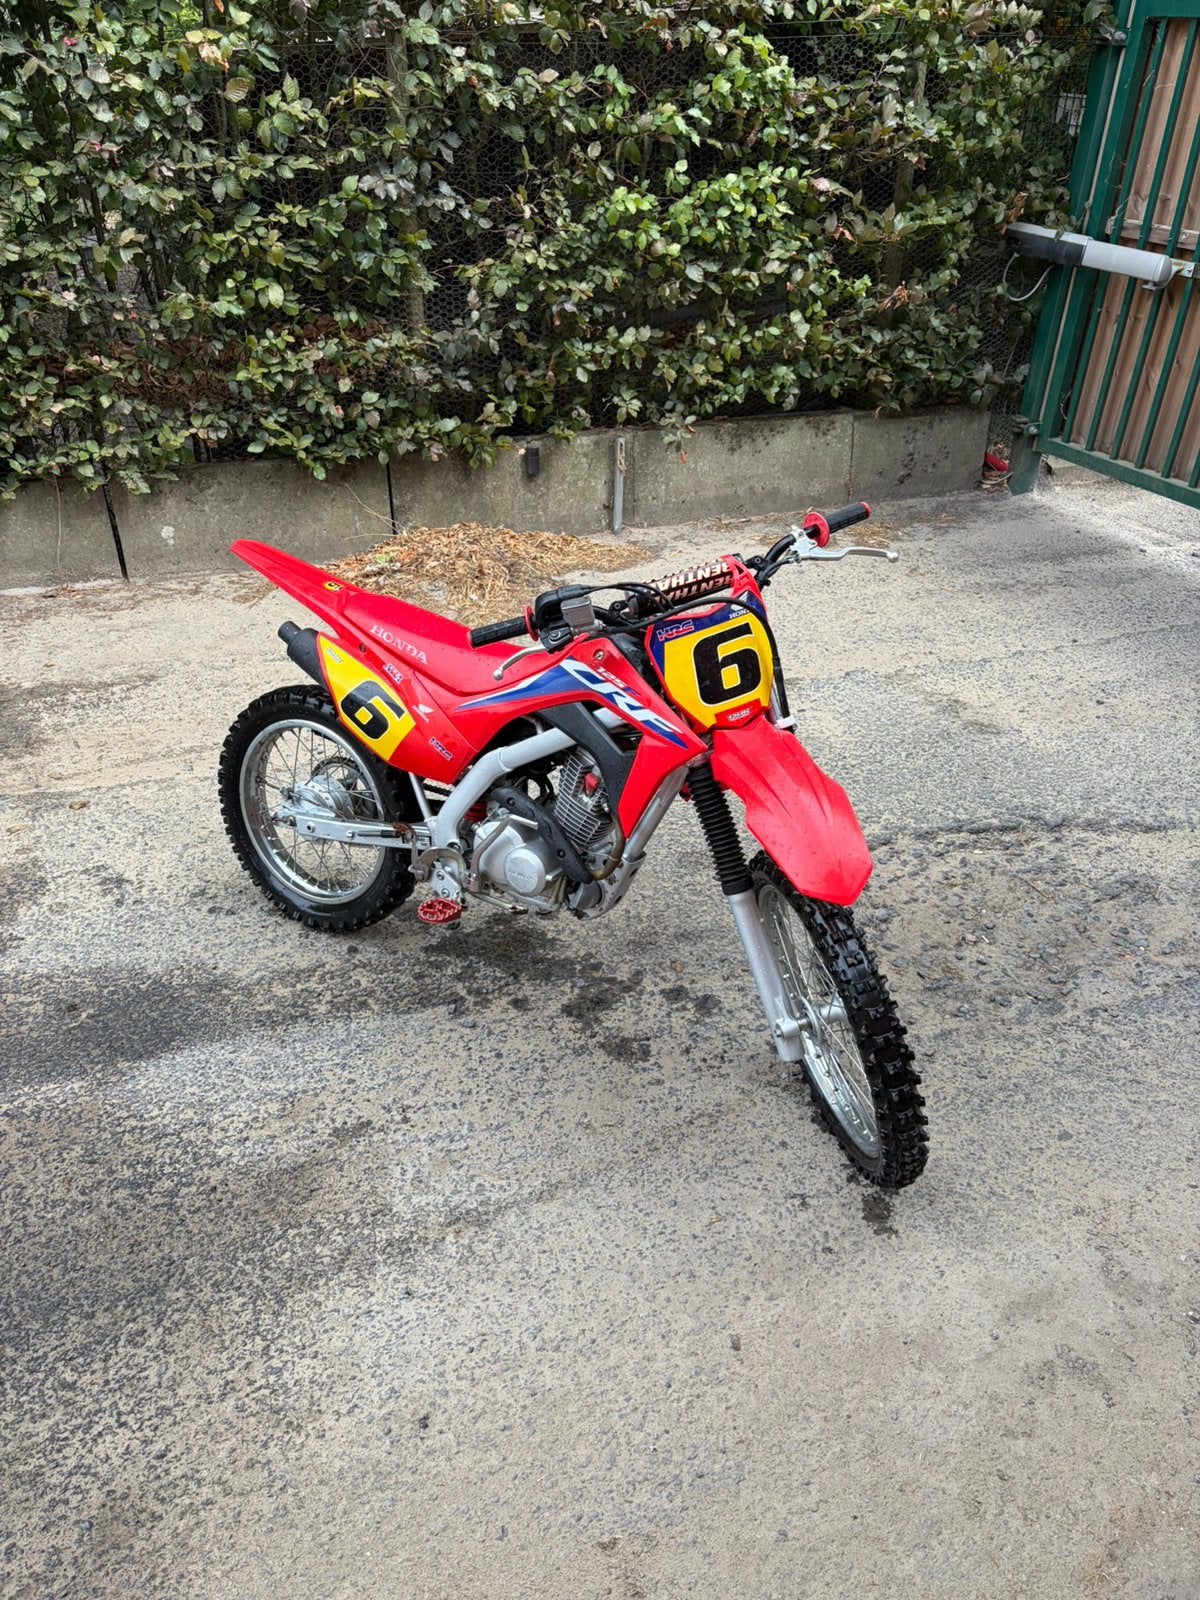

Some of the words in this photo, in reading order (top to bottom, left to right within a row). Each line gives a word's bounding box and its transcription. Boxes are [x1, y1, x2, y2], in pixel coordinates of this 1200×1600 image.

[370, 624, 427, 665] HONDA
[656, 620, 694, 641] HRC
[692, 622, 762, 707] 6
[341, 680, 406, 740] 6
[560, 659, 684, 734] CRF
